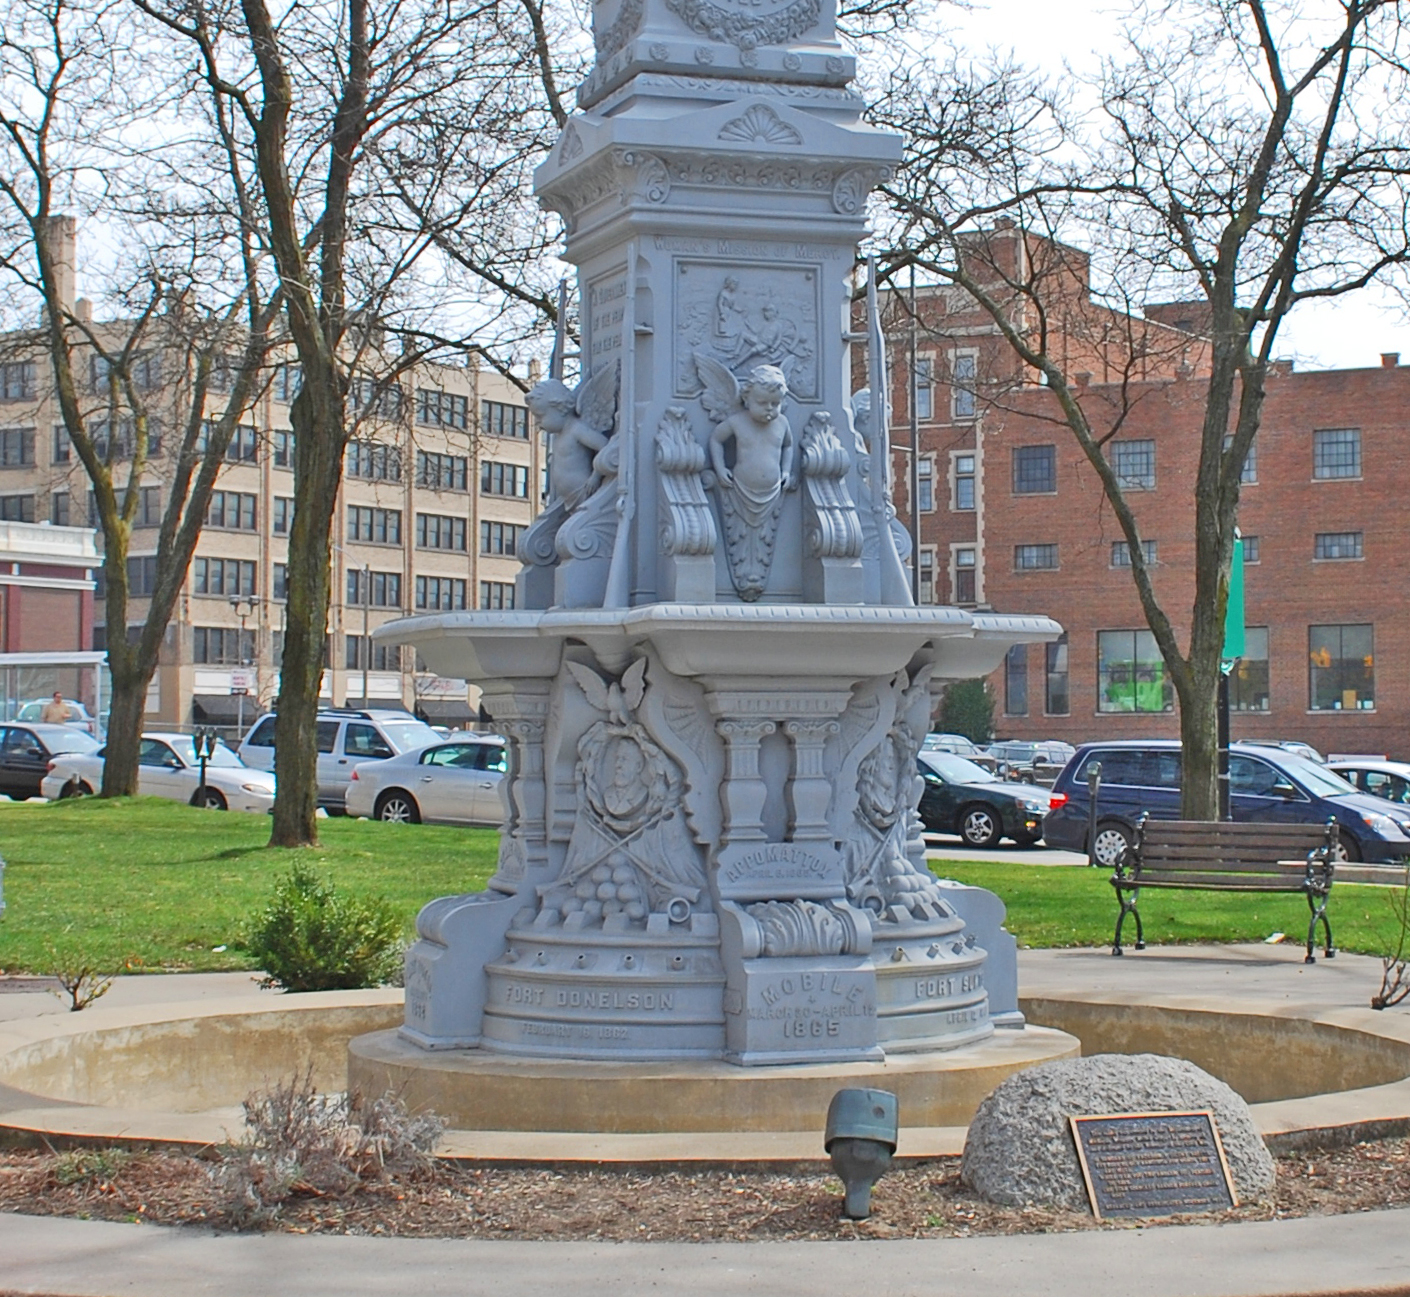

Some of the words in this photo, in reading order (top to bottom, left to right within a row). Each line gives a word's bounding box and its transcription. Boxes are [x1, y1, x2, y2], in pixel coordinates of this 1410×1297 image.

[726, 845, 832, 883] APPOMATTOX
[505, 984, 544, 1004] FORT
[556, 989, 674, 1011] DONELSON
[761, 973, 865, 1006] MOBILE
[915, 977, 956, 998] FORT
[783, 1019, 840, 1038] 1865
